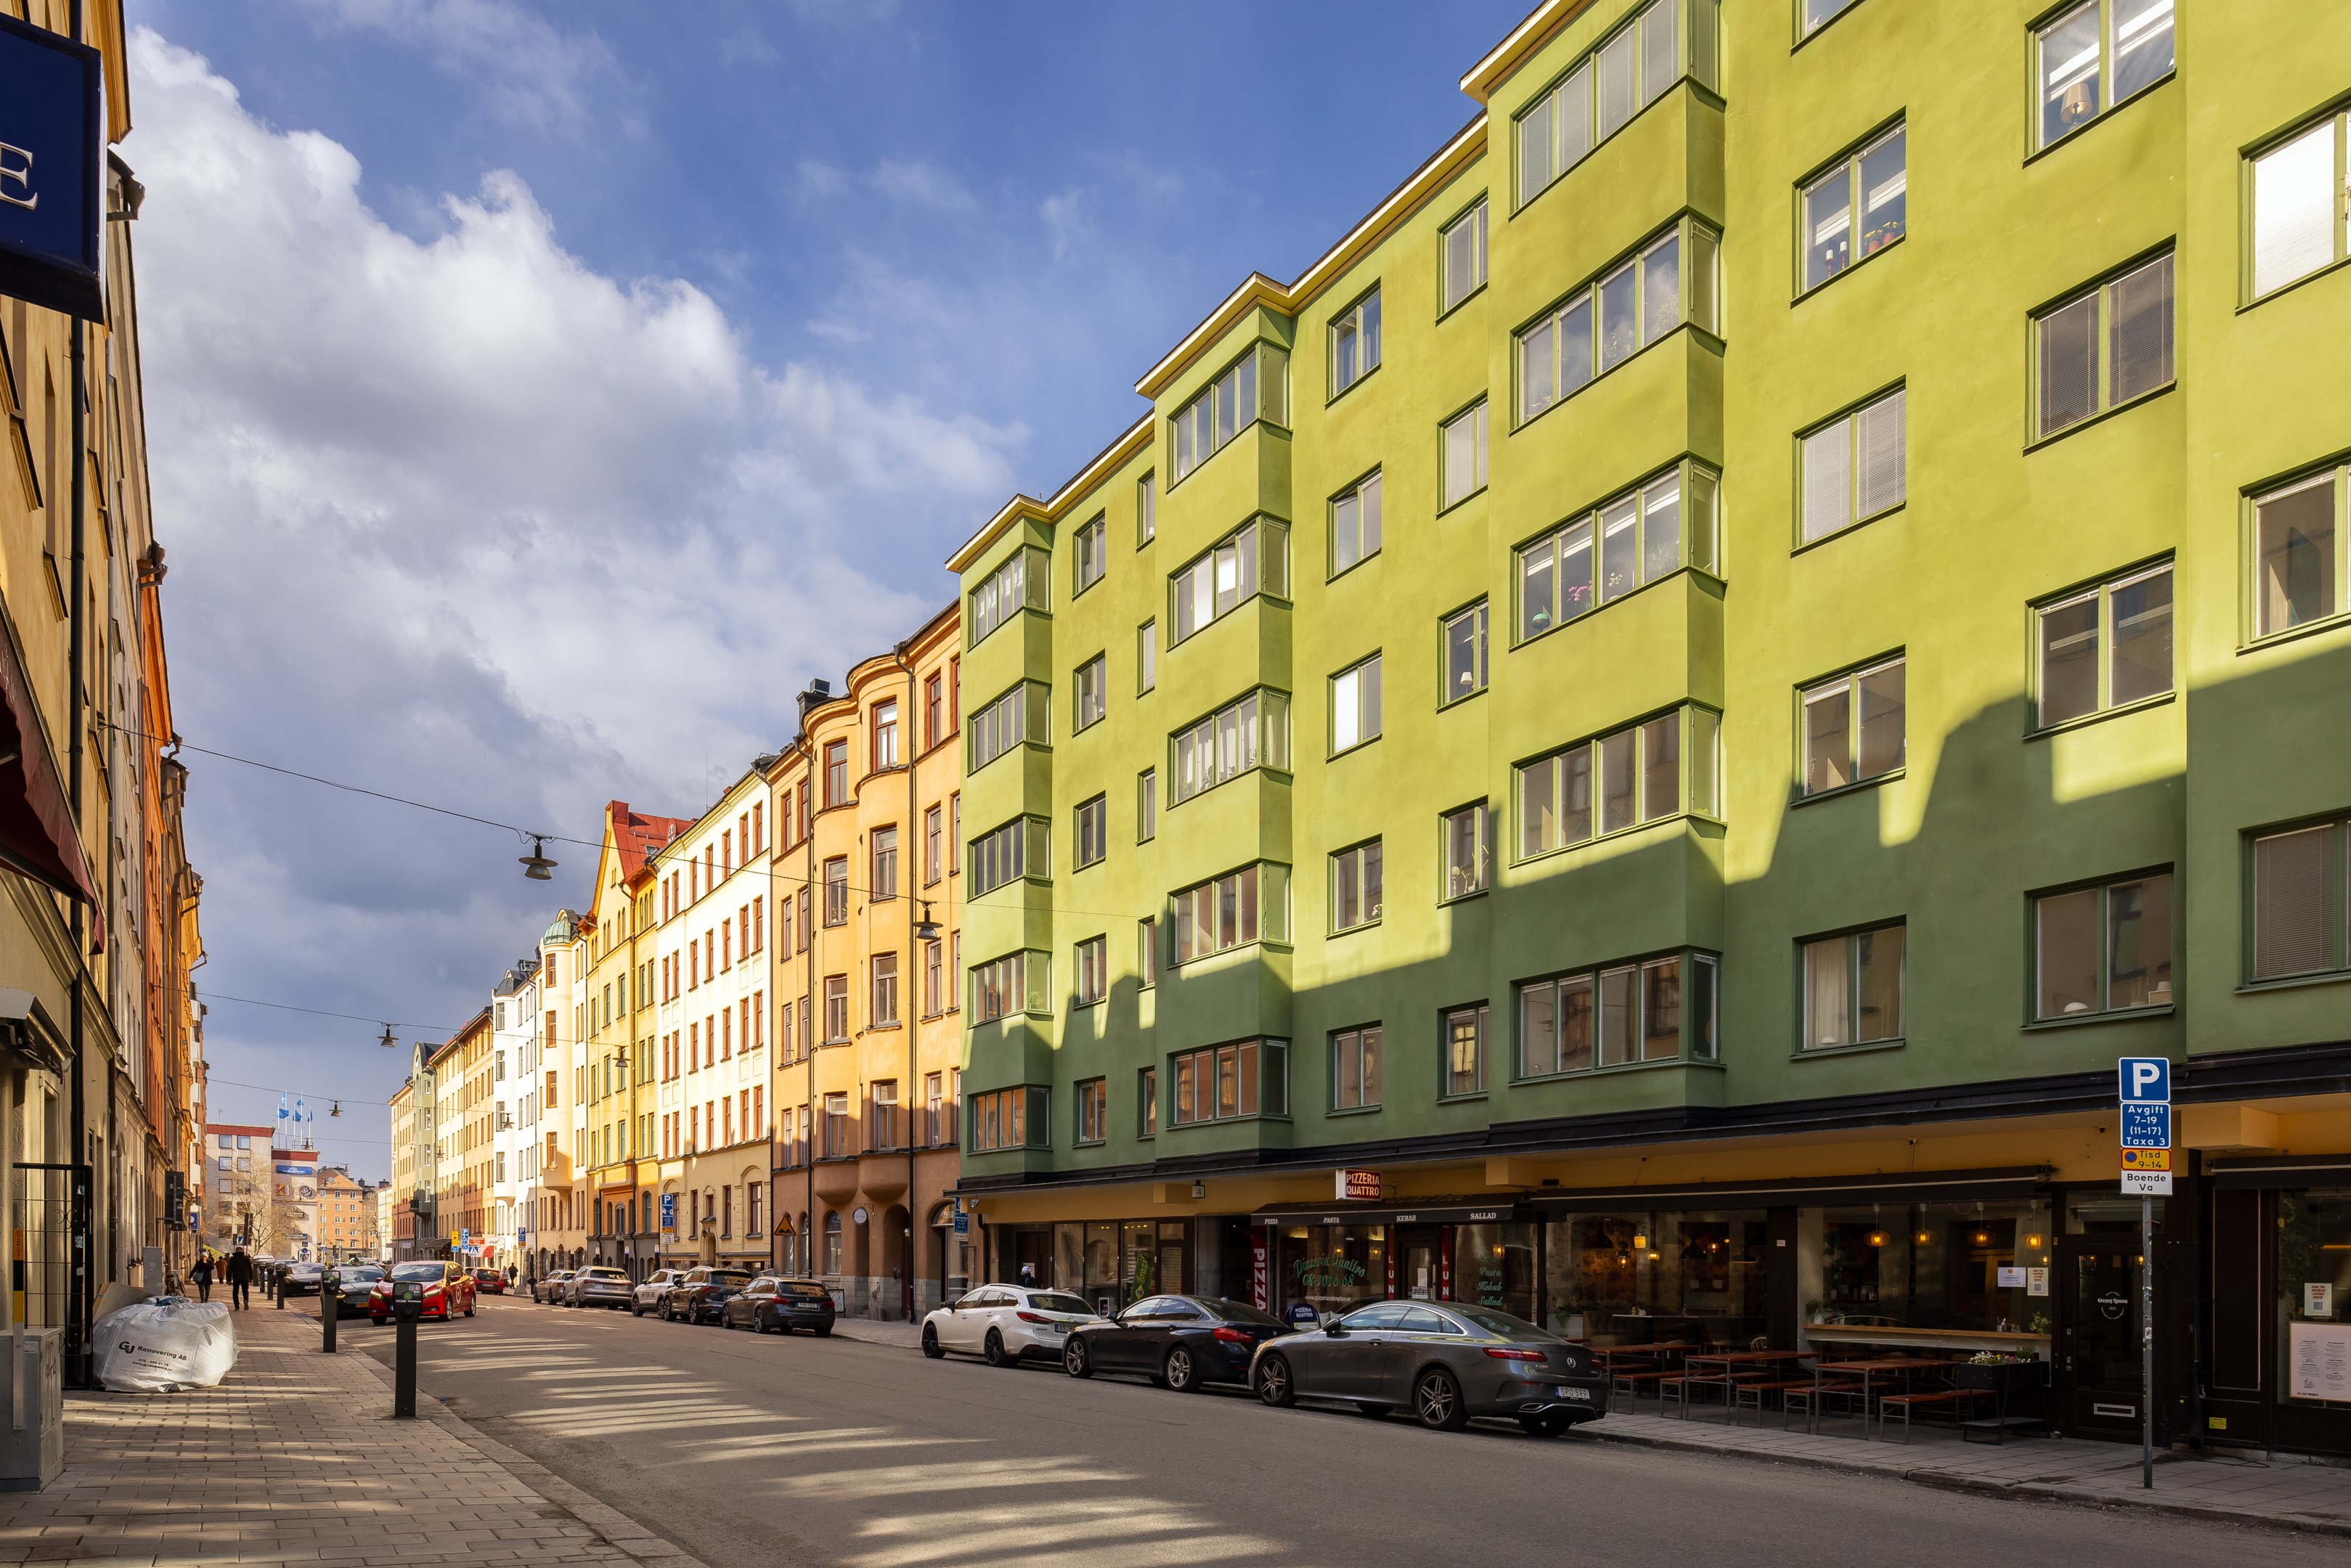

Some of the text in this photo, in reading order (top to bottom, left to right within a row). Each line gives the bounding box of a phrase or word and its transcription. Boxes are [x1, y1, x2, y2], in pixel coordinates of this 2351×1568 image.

[2132, 1062, 2160, 1097] P
[2127, 1105, 2164, 1116] Avgift
[2134, 1116, 2157, 1124] 7-19
[2130, 1125, 2161, 1135] (11-17)
[2126, 1137, 2154, 1146] Taxa
[1346, 1172, 1380, 1185] PIZZERIA
[2127, 1173, 2167, 1182] Boende
[1346, 1185, 1380, 1196] QUATTRO
[664, 1195, 671, 1204] P
[1293, 1252, 1330, 1278] Pizzeria
[1332, 1252, 1366, 1277] Quattro
[1479, 1267, 1502, 1277] Pasta
[1254, 1248, 1266, 1312] PIZZA
[1477, 1281, 1502, 1291] Kebab
[1478, 1296, 1502, 1306] Sallad
[137, 1345, 177, 1359] Renovering
[1560, 1387, 1587, 1398] SPO 599
